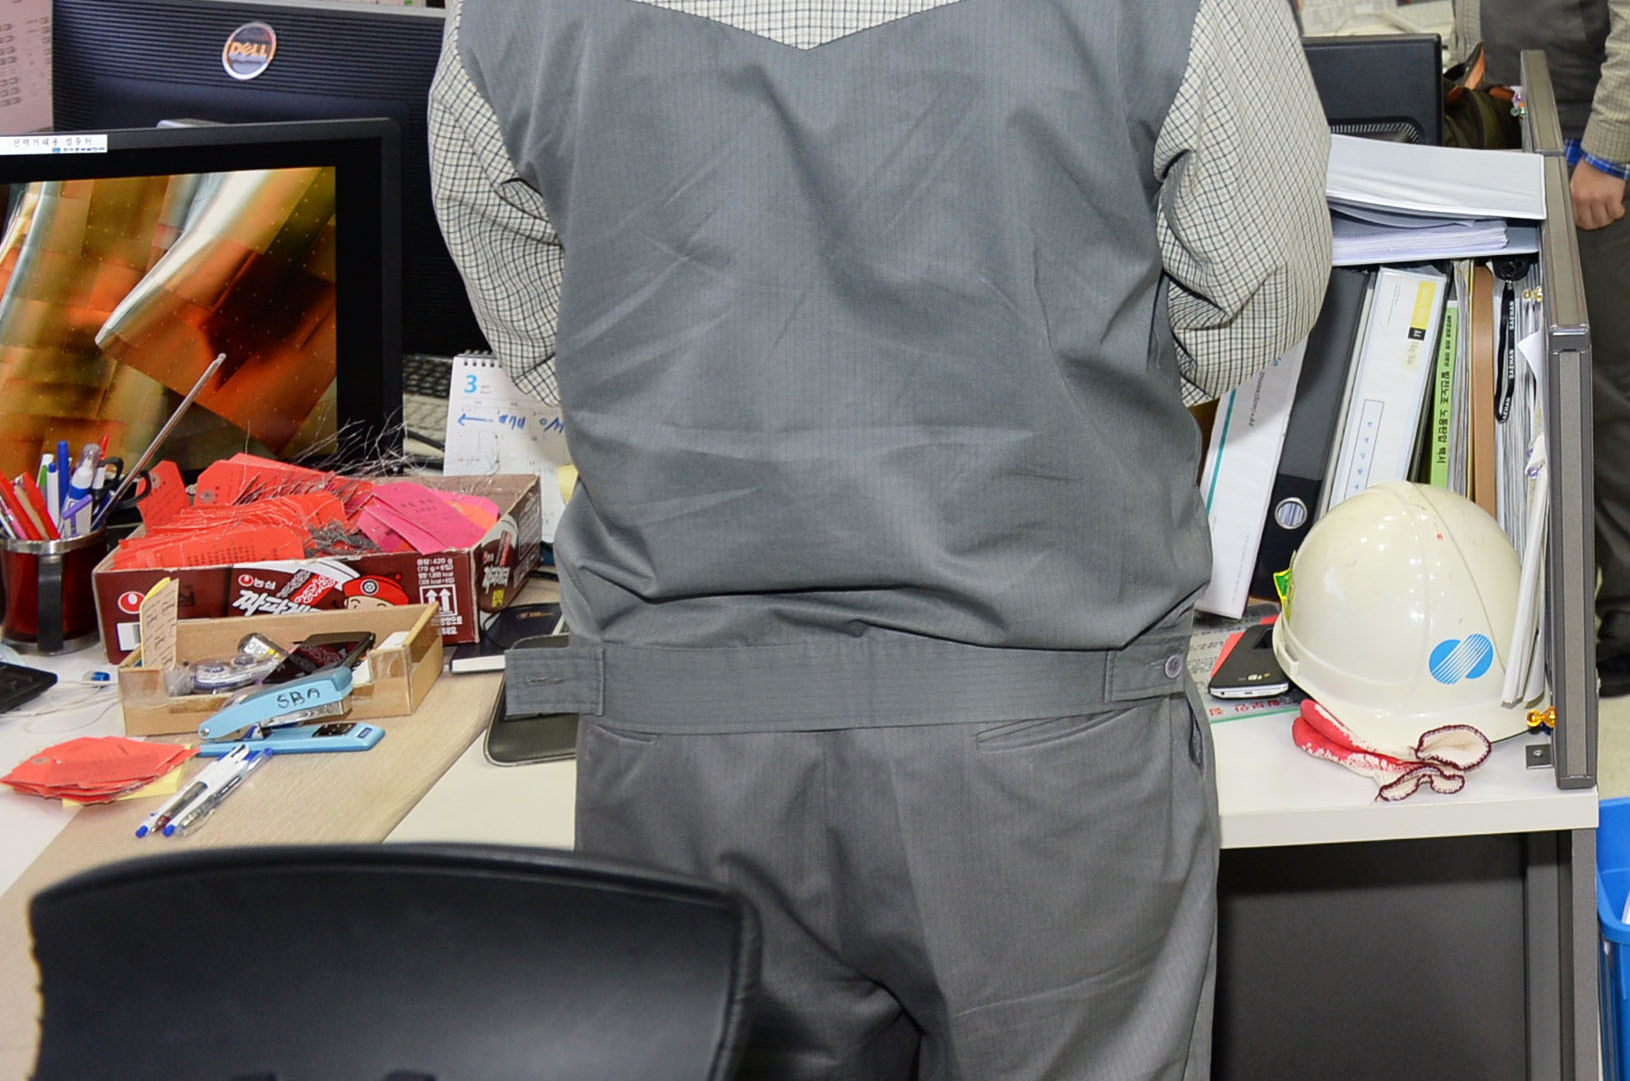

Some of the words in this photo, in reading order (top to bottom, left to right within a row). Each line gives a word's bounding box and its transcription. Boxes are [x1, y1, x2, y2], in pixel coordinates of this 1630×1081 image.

[229, 41, 268, 56] DELL
[464, 374, 478, 394] 3
[1439, 370, 1451, 405] 발전노조
[1437, 410, 1449, 444] 노동탄압
[253, 578, 276, 590] 농심
[232, 590, 323, 617] 짜파게
[276, 687, 320, 709] SBA
